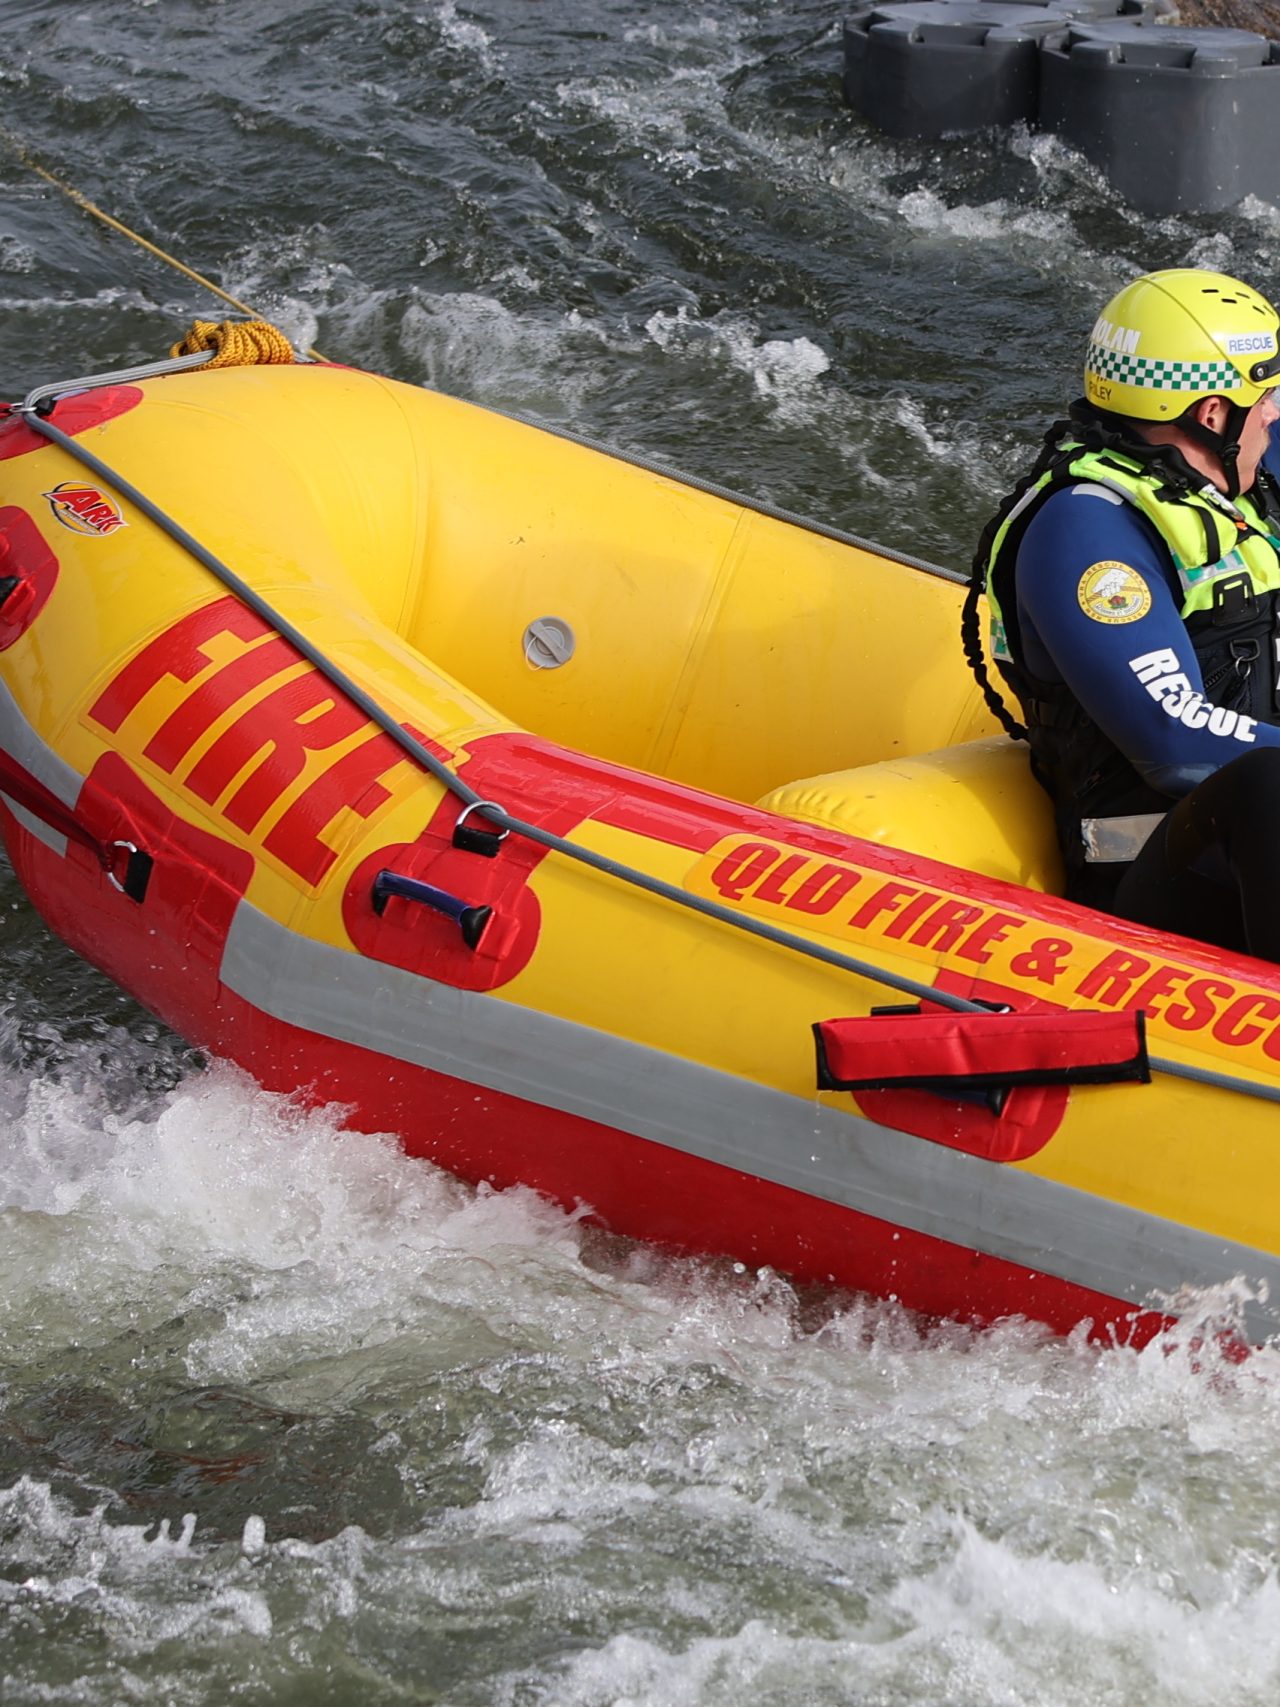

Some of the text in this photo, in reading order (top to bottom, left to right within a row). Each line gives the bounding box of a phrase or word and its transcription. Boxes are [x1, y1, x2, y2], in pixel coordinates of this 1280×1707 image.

[1229, 336, 1274, 352] RESCUE
[48, 490, 126, 532] ARK
[87, 594, 456, 888] FIRE
[1128, 647, 1258, 743] RESCUE
[709, 841, 863, 917] QLD
[847, 882, 1028, 964] FIRE
[1010, 937, 1075, 986] &
